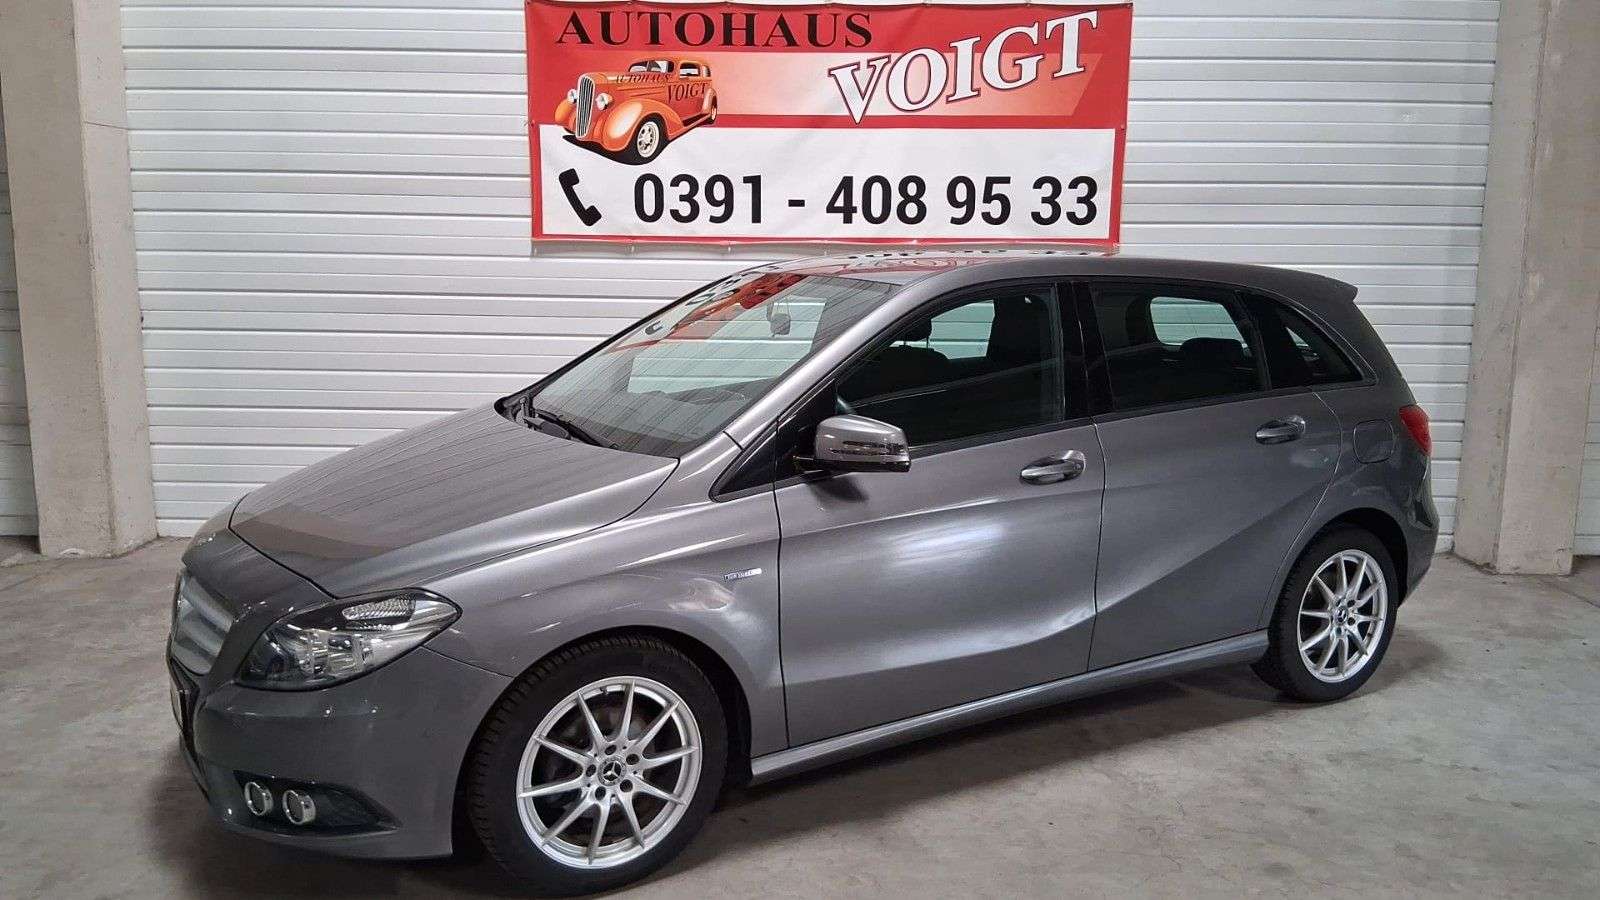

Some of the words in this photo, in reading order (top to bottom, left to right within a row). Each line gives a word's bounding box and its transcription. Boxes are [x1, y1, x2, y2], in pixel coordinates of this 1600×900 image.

[556, 11, 872, 48] AUTOHAUS
[828, 10, 1099, 125] VOIGT
[667, 82, 709, 103] VOIGT
[633, 173, 762, 224] 0391
[788, 198, 806, 208] -
[825, 174, 928, 225] 408
[946, 175, 1012, 226] 95
[1030, 175, 1098, 226] 33
